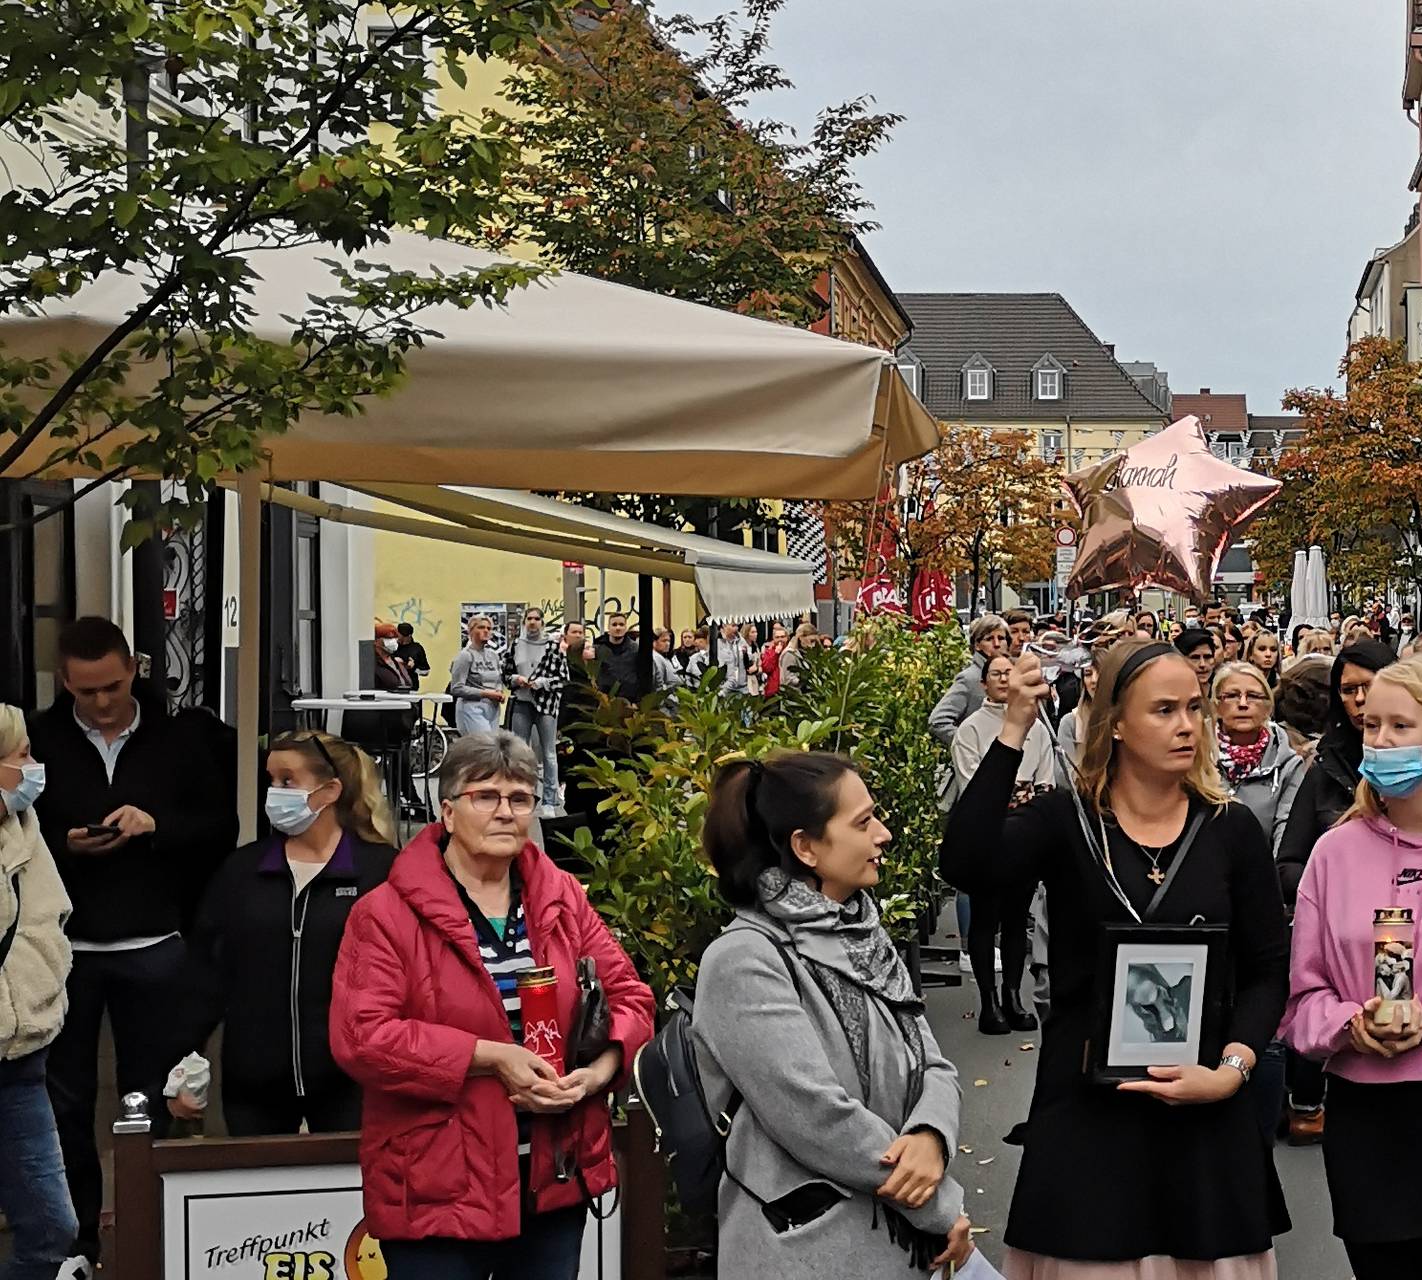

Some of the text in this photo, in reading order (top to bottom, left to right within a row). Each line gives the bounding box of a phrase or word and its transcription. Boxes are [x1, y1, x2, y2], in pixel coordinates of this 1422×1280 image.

[1104, 453, 1178, 491] Hannah
[225, 596, 238, 628] 12
[204, 1218, 331, 1269] Treffpunkt
[263, 1251, 336, 1280] EIS
